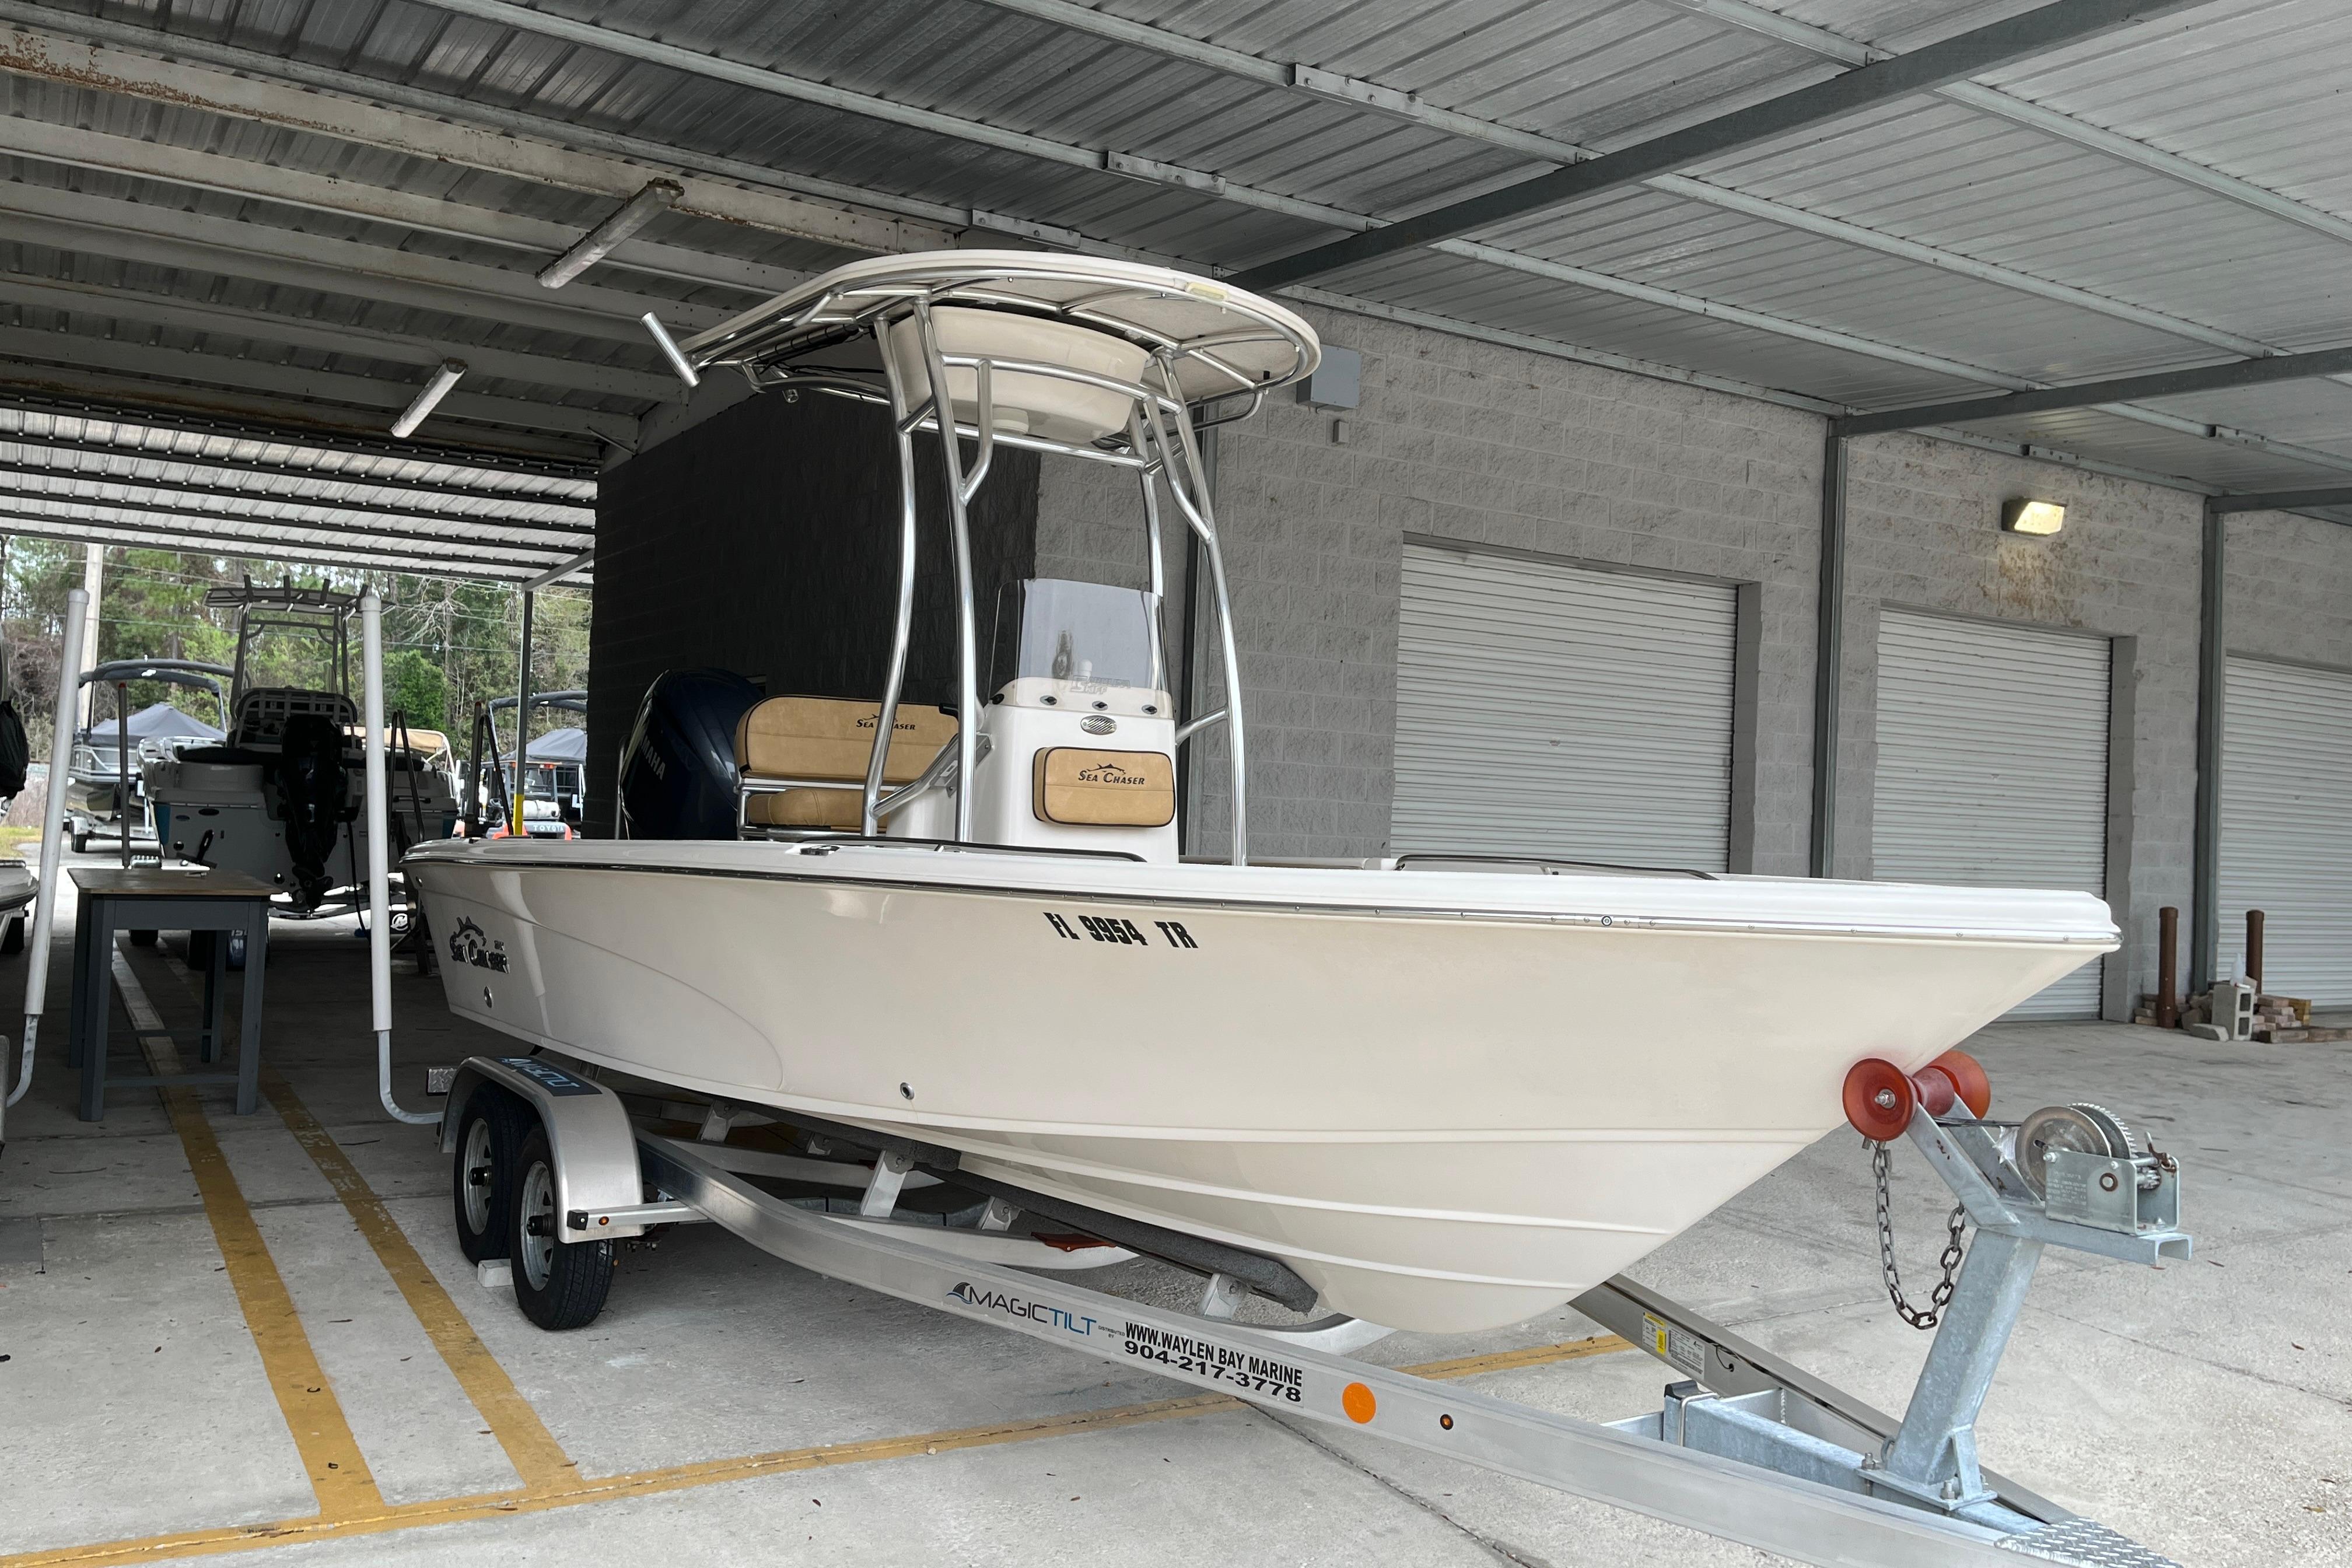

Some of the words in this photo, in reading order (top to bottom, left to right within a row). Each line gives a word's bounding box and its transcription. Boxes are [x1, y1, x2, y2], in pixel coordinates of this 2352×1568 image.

[856, 719, 874, 728] SEA
[1078, 770, 1098, 782] SEA
[1103, 772, 1145, 785] CHASER
[1042, 912, 1081, 940] FL
[1078, 915, 1149, 946] 9954
[1153, 921, 1199, 949] TR
[968, 1286, 1097, 1336] MAGICTILT
[1124, 1340, 1301, 1402] 904-217-3778
[1125, 1321, 1214, 1362] WWW.WAYLEN
[1219, 1348, 1245, 1370] BAY
[1249, 1356, 1303, 1387] MARINE
